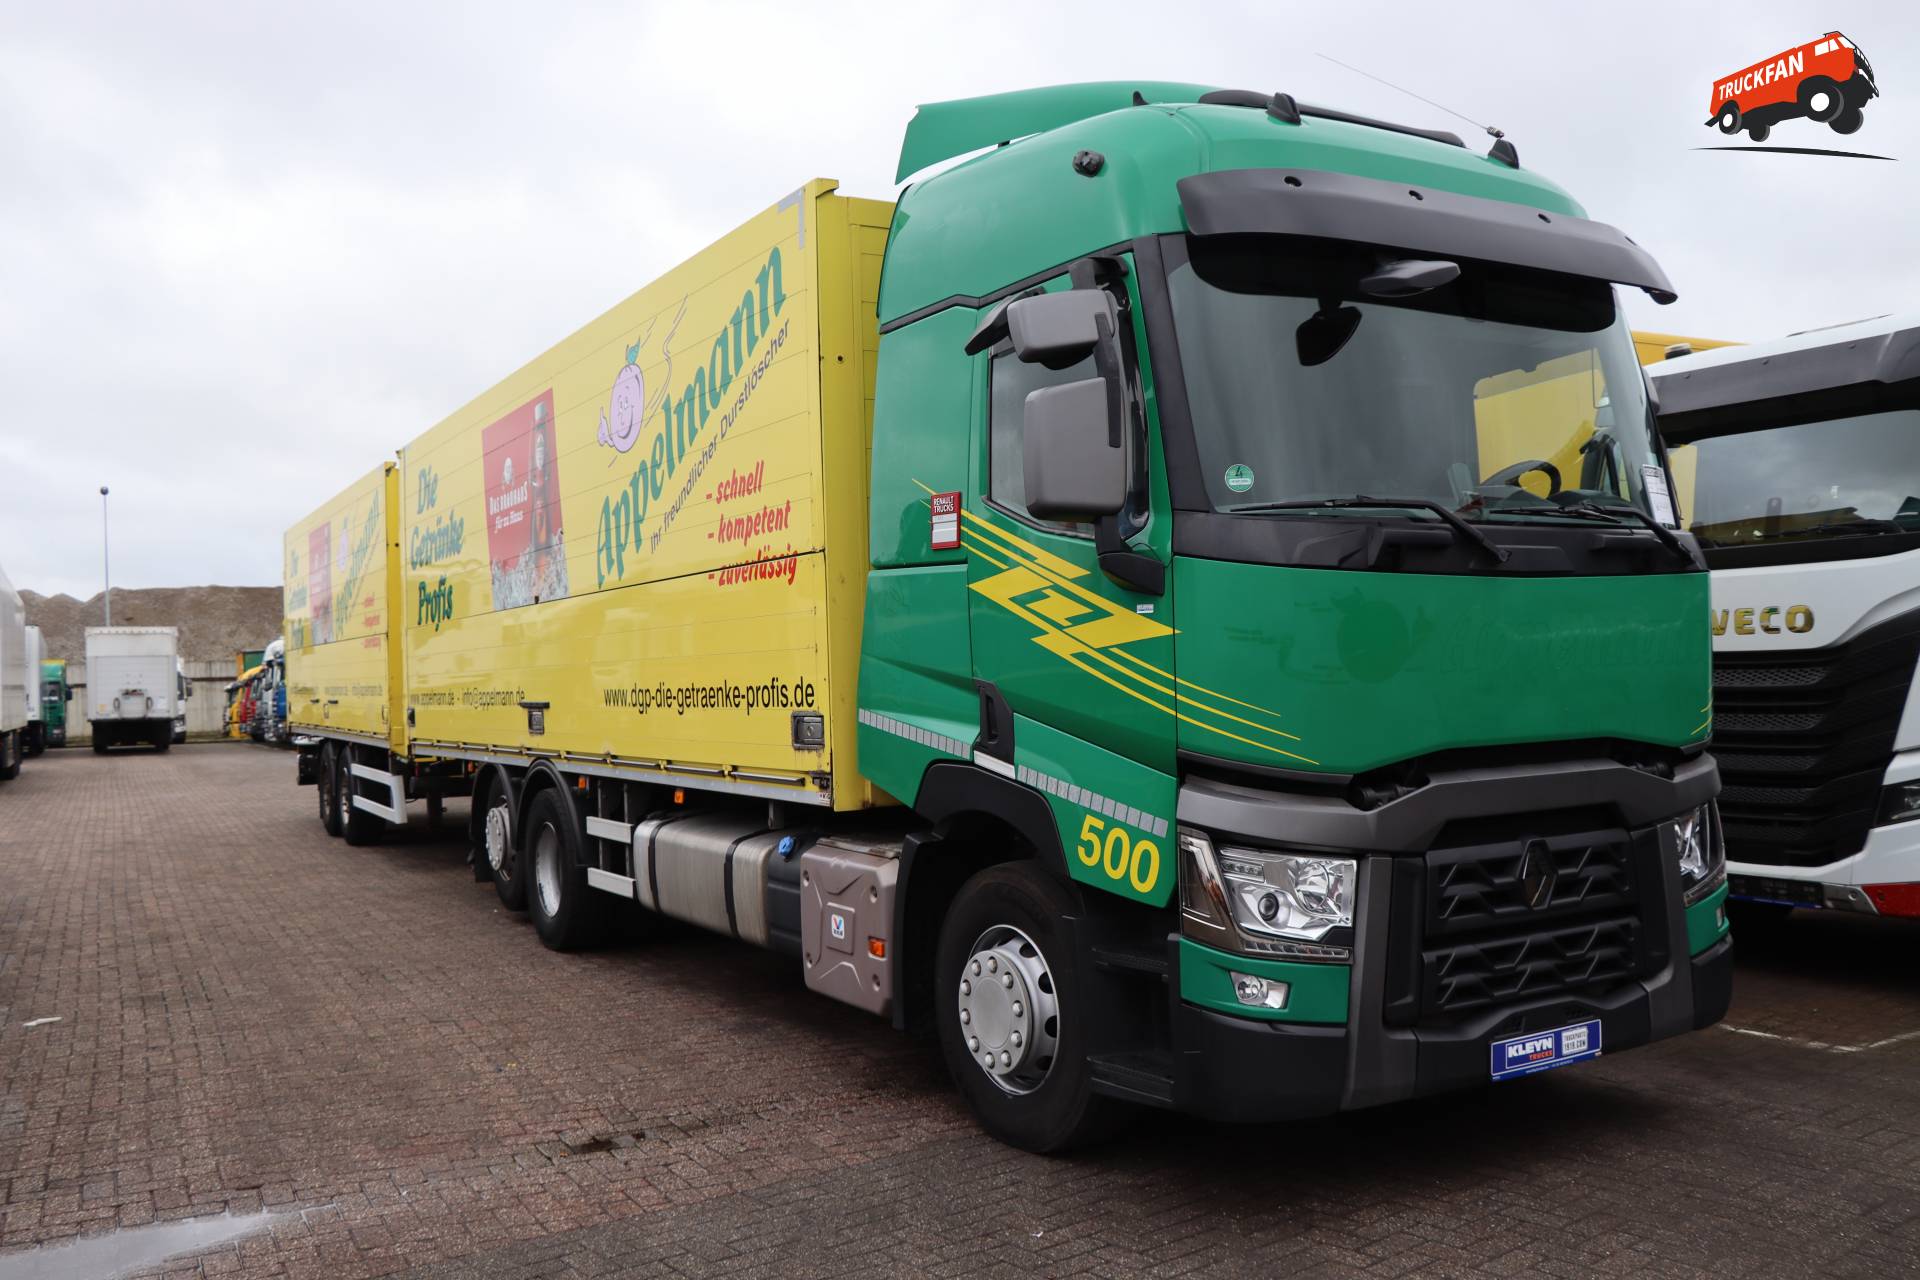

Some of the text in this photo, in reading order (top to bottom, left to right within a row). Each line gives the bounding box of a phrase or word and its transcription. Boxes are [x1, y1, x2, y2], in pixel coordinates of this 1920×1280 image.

[597, 246, 787, 590] Appelmann
[650, 318, 790, 554] Ihr freundlicher Durstlöscher
[417, 464, 438, 515] Die
[716, 459, 764, 504] schnell
[933, 495, 954, 506] RENAULT
[718, 499, 791, 546] kompetent
[933, 503, 954, 513] TRUCKS
[411, 509, 464, 571] Getränke
[719, 543, 798, 586] zuverlässig
[417, 576, 453, 632] Profis
[1711, 604, 1815, 636] VECO
[603, 676, 815, 716] www.dgp-die-getraenke-profis.de
[1077, 814, 1160, 893] 500
[1507, 1037, 1553, 1058] KLEYN
[1529, 1050, 1553, 1061] TRUCKS
